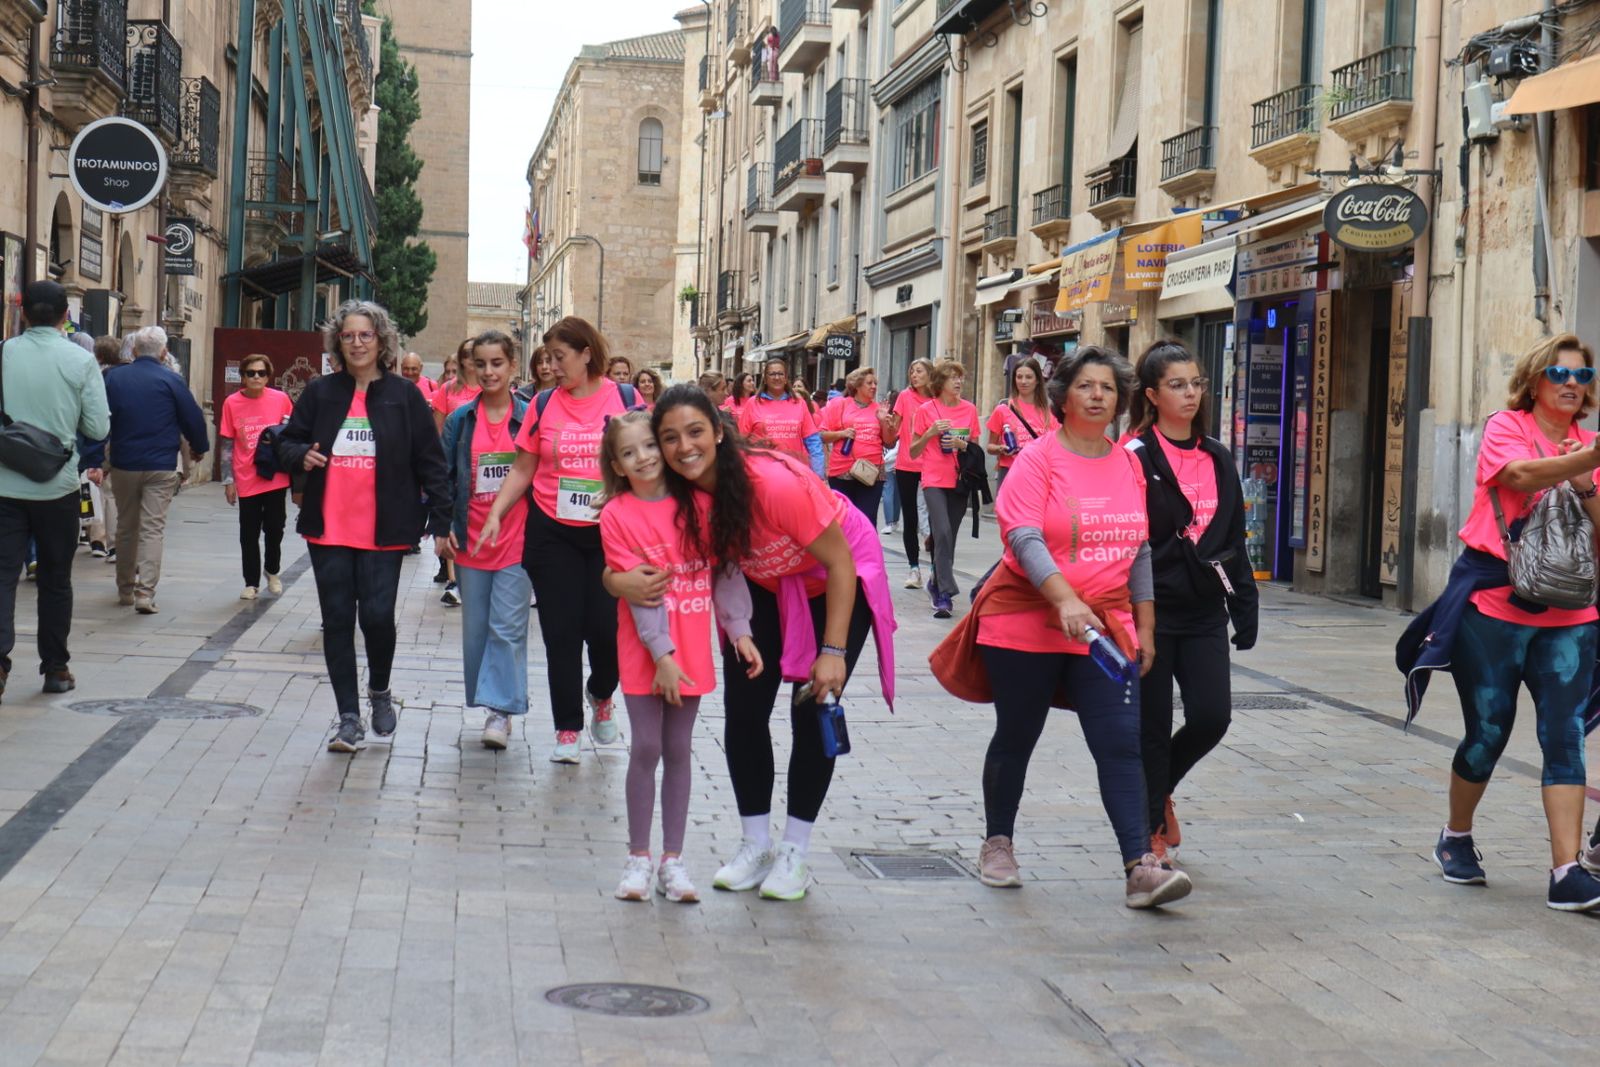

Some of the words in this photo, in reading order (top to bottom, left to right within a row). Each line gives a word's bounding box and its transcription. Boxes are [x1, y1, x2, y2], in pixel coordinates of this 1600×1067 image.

[76, 158, 158, 171] TROTAMUNDOS
[103, 176, 130, 188] Shop
[1336, 194, 1414, 222] Coca-Cola
[1166, 264, 1211, 288] CROISSANTERIA
[1214, 259, 1232, 278] PARIS
[1314, 307, 1327, 475] CROISSANTERIA
[560, 431, 577, 441] En
[1252, 449, 1274, 457] BOTE
[569, 492, 597, 506] 410
[1080, 512, 1100, 525] En
[1312, 495, 1321, 557] PARIS
[1081, 526, 1137, 542] contra
